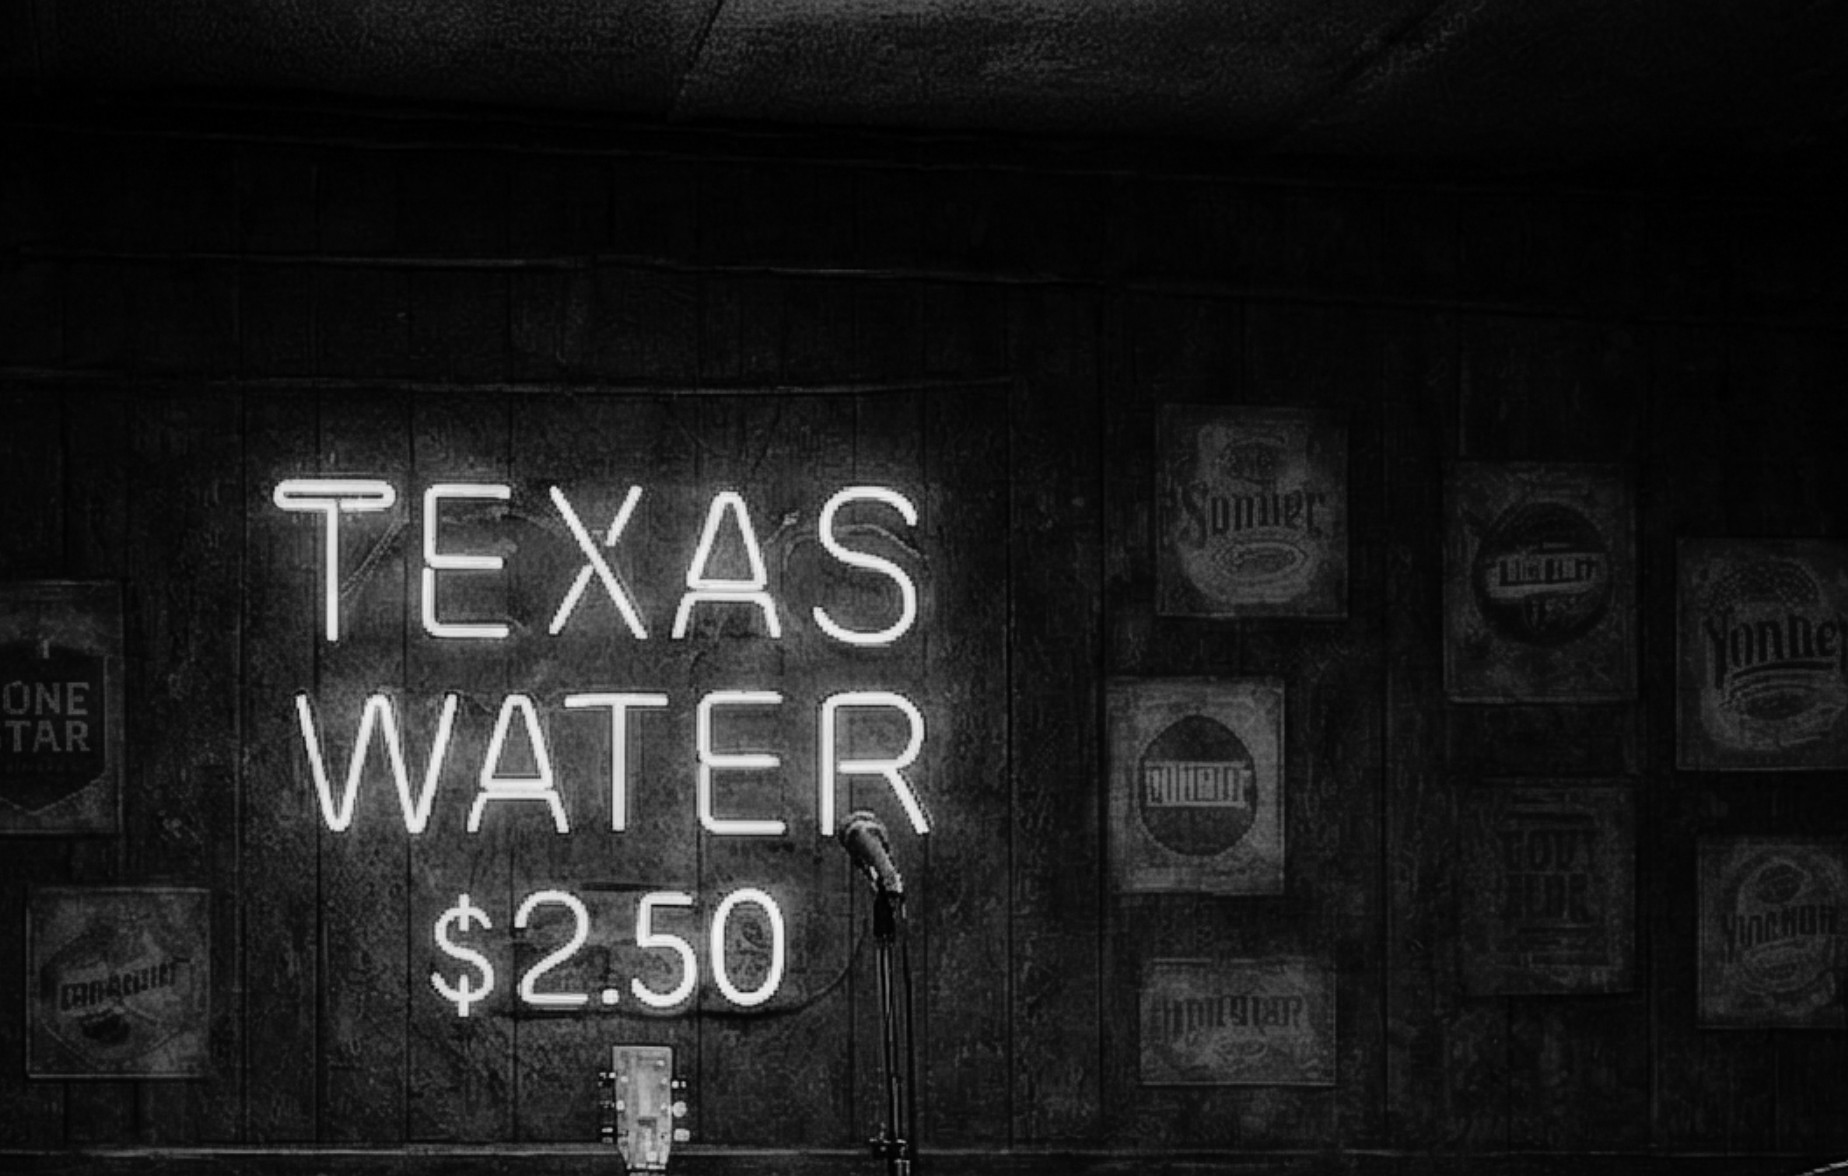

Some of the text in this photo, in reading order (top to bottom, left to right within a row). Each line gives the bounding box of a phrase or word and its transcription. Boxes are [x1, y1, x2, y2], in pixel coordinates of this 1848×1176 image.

[272, 478, 920, 646] TEXAS
[294, 690, 934, 836] WATER
[430, 886, 786, 1018] $2.50
